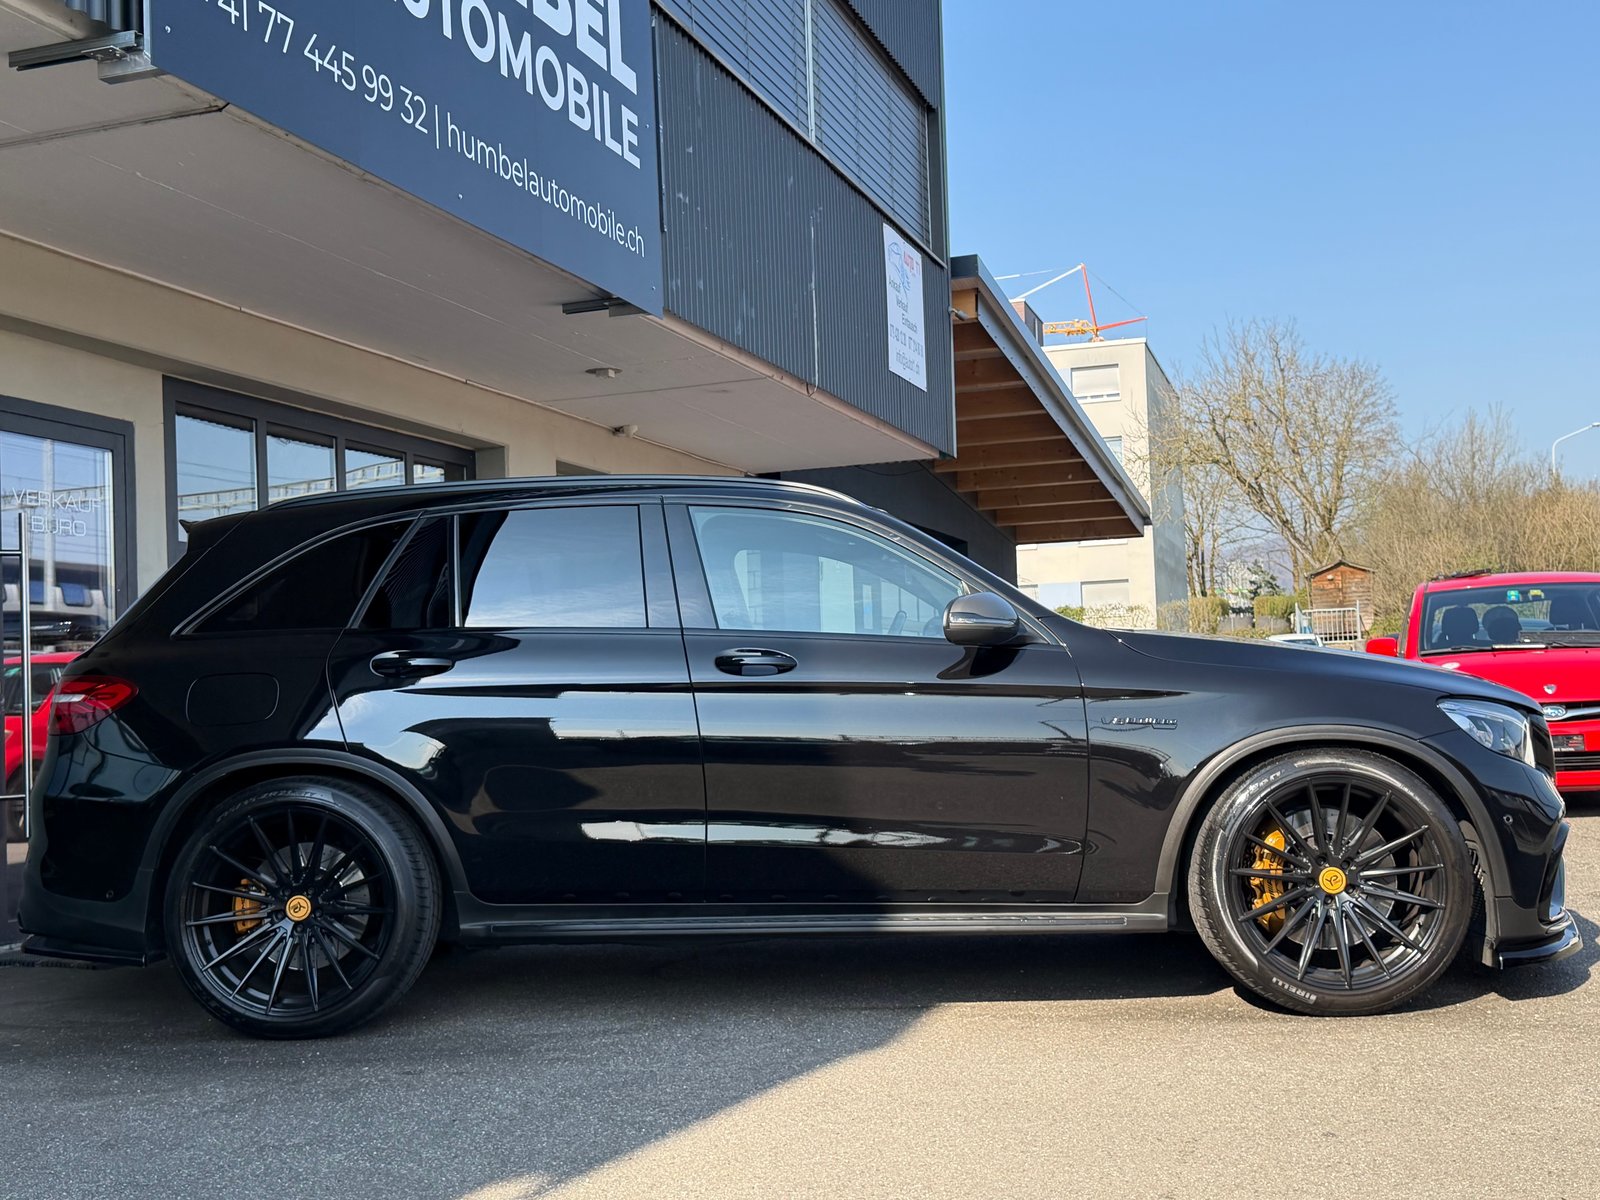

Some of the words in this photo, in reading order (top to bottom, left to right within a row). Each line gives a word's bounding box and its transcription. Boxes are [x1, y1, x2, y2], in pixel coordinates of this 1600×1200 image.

[258, 1, 294, 54] 77
[303, 33, 357, 91] 445
[362, 64, 394, 112] 99
[399, 85, 428, 134] 32
[447, 111, 645, 258] humbelautomobile.ch
[12, 487, 102, 513] VERKAUF
